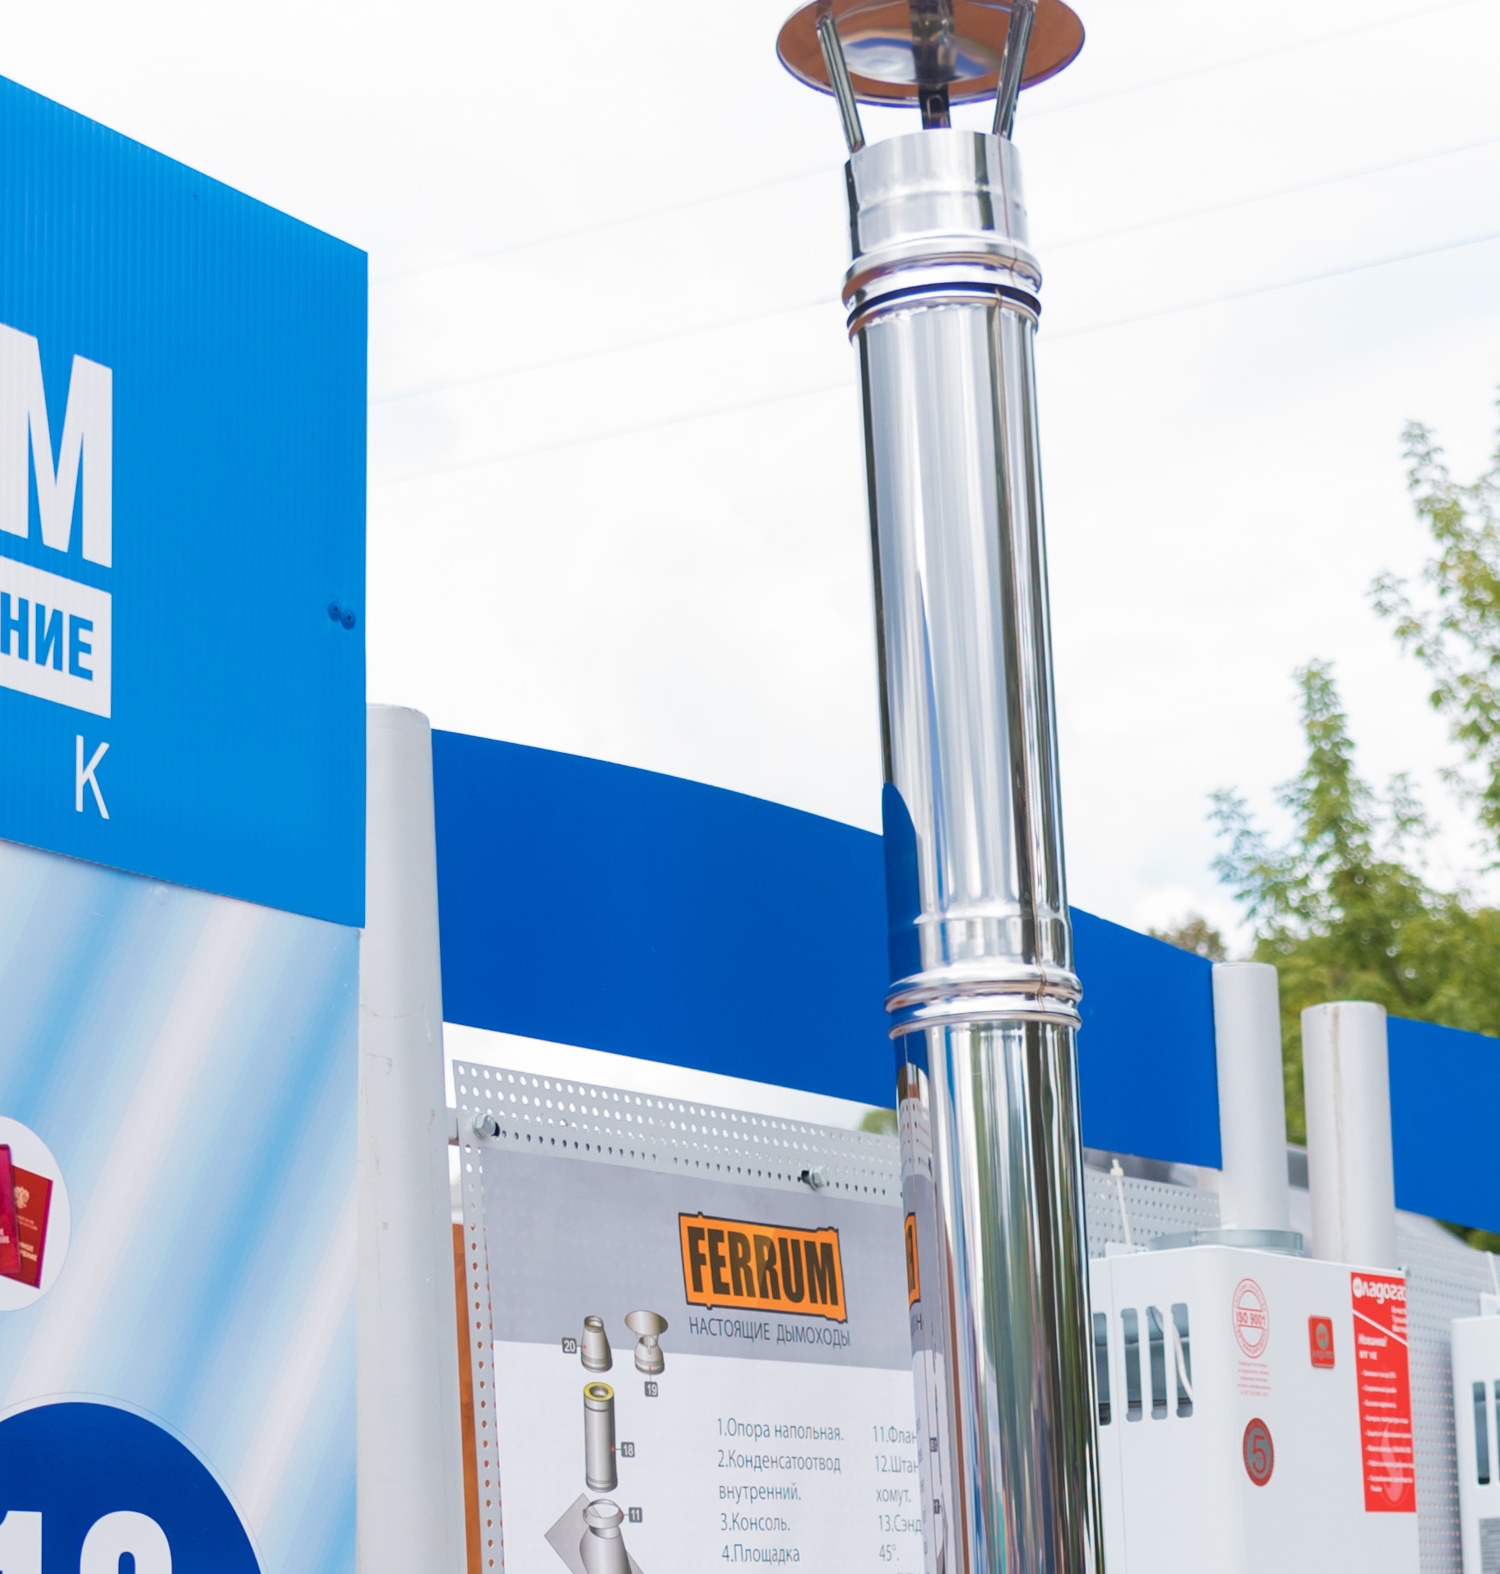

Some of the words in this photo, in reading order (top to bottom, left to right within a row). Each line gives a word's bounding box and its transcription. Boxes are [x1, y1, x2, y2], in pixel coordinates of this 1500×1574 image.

[687, 1225, 839, 1306] FERRUM
[688, 1316, 771, 1341] НАСТОЯЩИЕ
[776, 1323, 850, 1350] ДЫМОХОДЫ
[717, 1418, 770, 1442] 1.Опора
[774, 1425, 844, 1442] напольная.
[717, 1450, 841, 1475] 2.Конденсатоотвод
[719, 1483, 802, 1504] внутренний.
[876, 1488, 911, 1506] хомут.
[720, 1513, 791, 1532] 3.Консоль.
[722, 1544, 800, 1566] 4.Площадка
